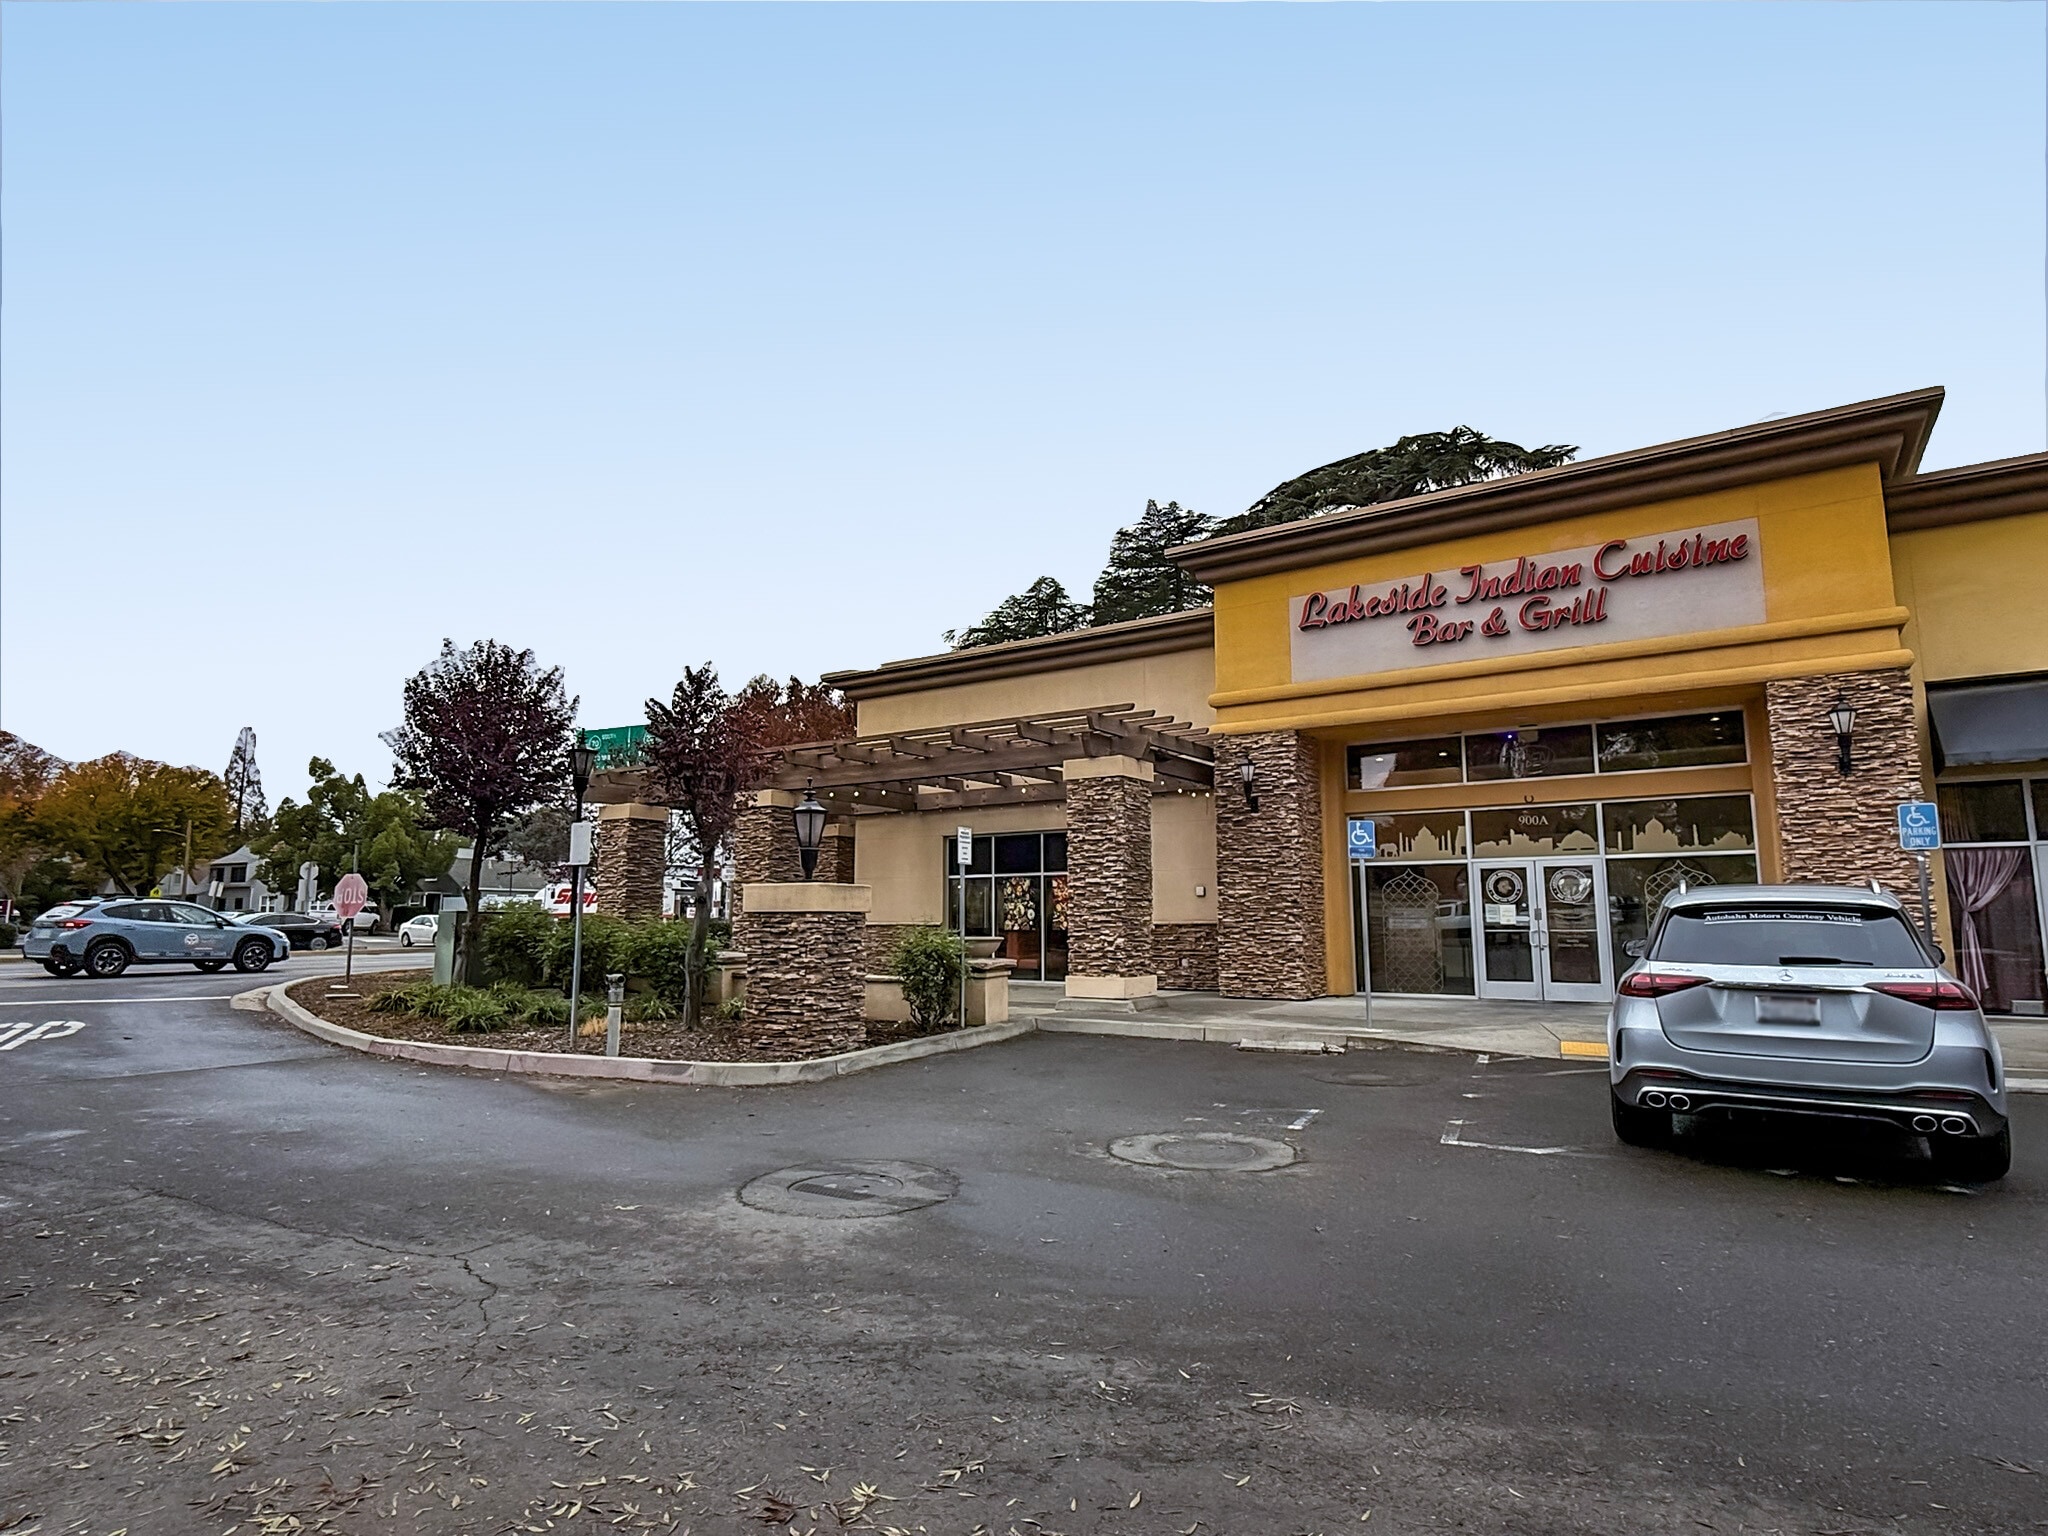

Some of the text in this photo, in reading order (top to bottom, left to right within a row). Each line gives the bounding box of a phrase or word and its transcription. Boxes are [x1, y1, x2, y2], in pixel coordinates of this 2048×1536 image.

[1298, 532, 1749, 631] Lakeside Indian Cuisine
[1406, 586, 1609, 646] Bar & Grill
[1518, 815, 1549, 825] 900A
[1902, 827, 1937, 836] PARKING
[1910, 837, 1931, 846] ONLY
[336, 887, 364, 905] STOP
[1704, 912, 1861, 923] Autobahn Motors Courtesy Vehicle
